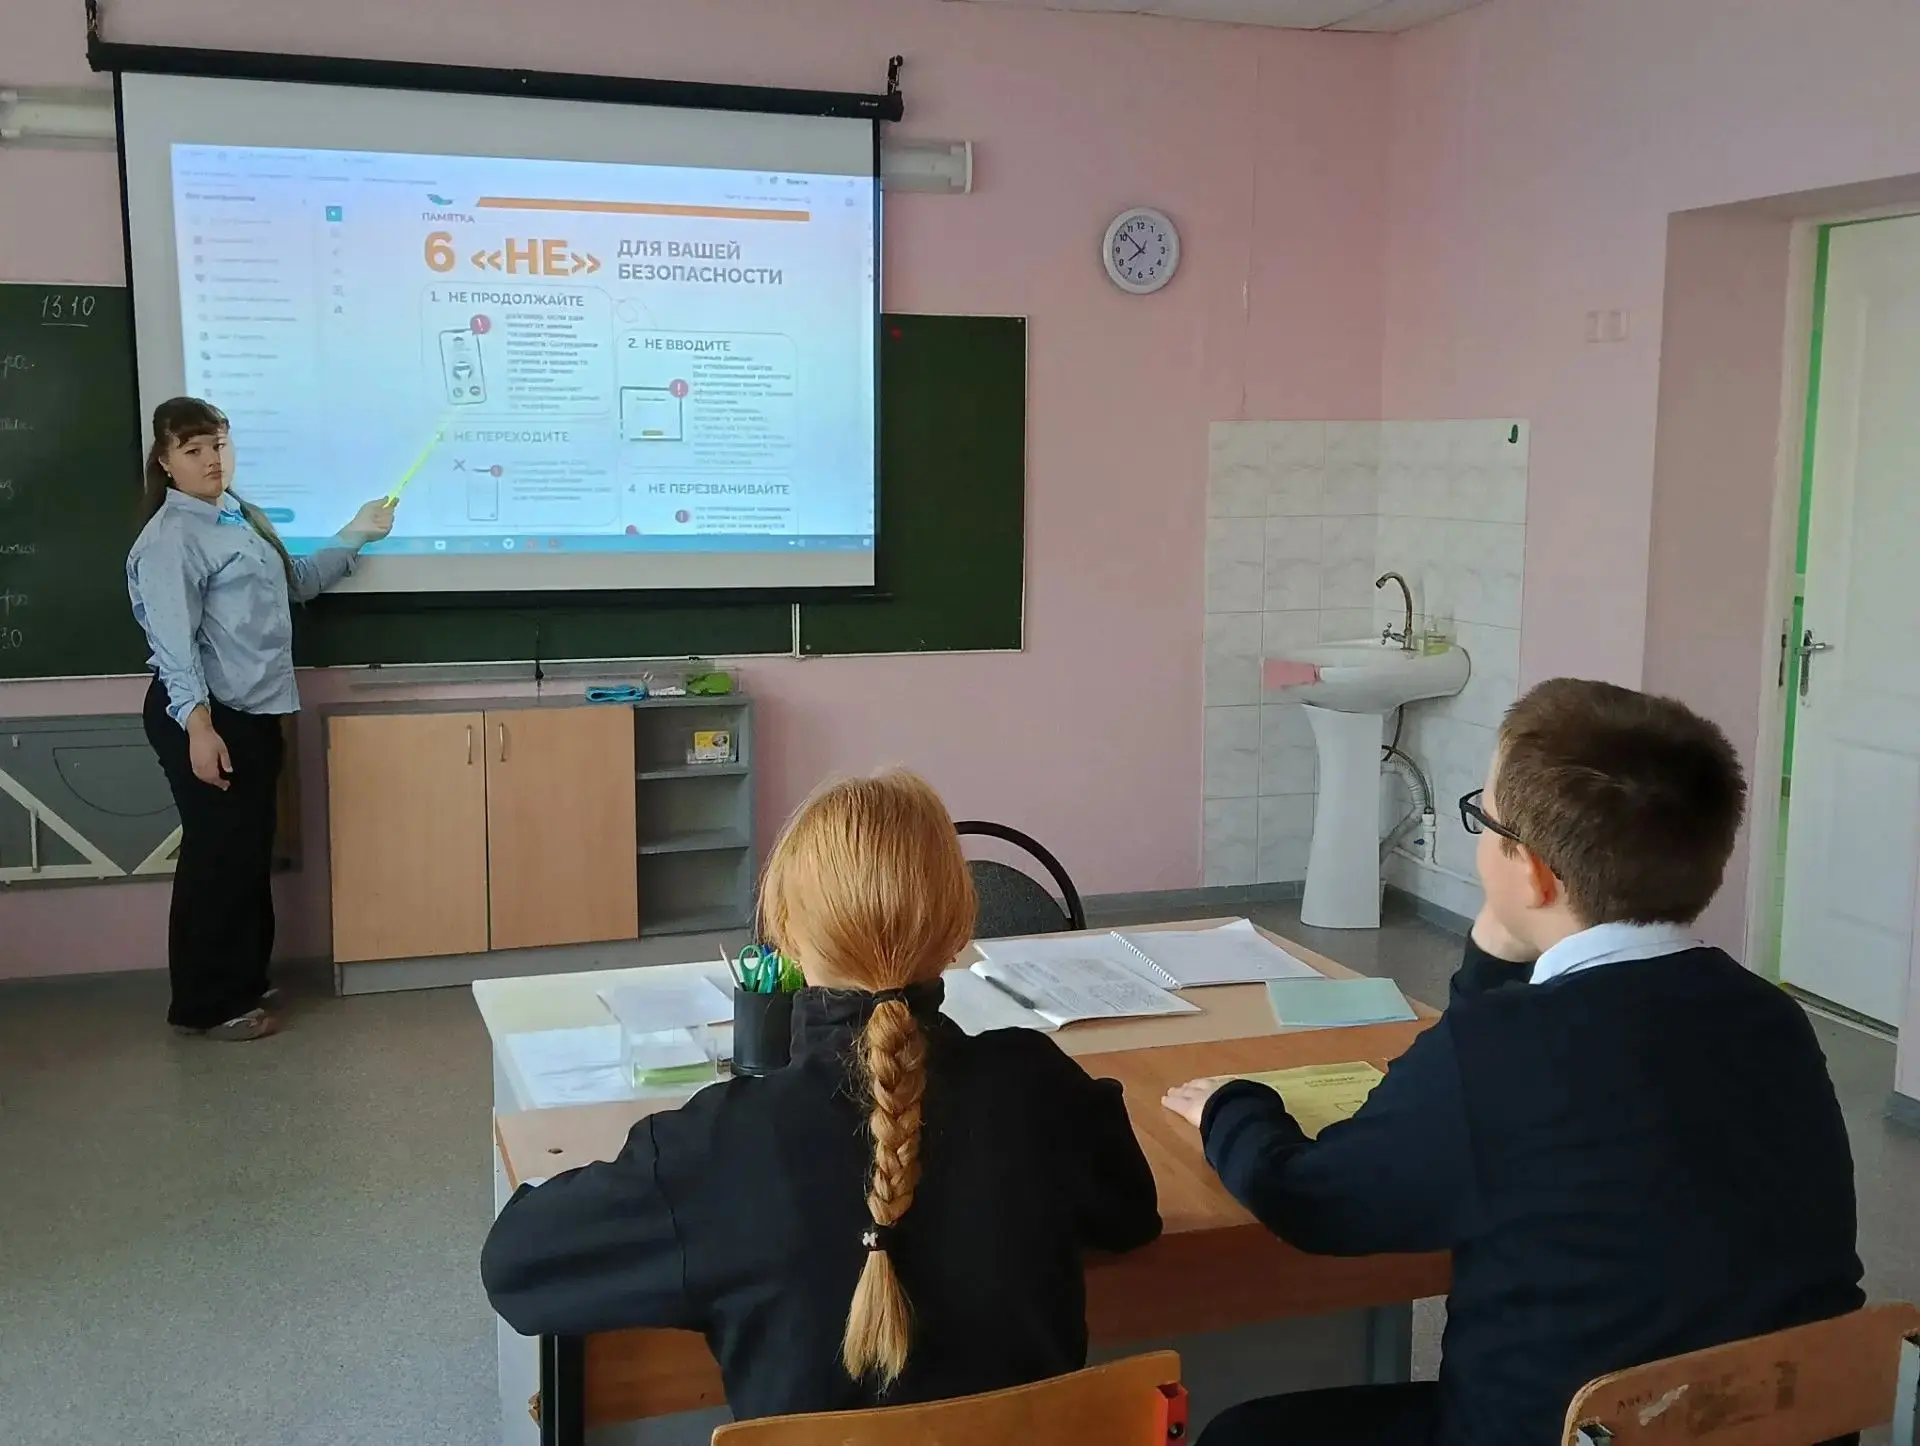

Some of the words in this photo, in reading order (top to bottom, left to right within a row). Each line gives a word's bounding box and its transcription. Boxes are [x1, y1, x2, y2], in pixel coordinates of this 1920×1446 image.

[421, 212, 475, 224] ПАМЯТКА
[424, 231, 456, 273] 6
[617, 239, 662, 258] ДЛЯ
[667, 241, 741, 260] ВАШЕЙ
[617, 263, 783, 285] БЕЗОПАСНОСТИ
[448, 292, 467, 303] НЕ
[471, 292, 585, 307] ПРОДОЛЖАЙТЕ
[645, 339, 662, 350] НЕ
[666, 340, 732, 351] ВВОДИТЕ
[454, 432, 472, 442] НЕ
[477, 432, 570, 443] ПЕРЕХОДИТЕ
[649, 484, 666, 493] НЕ
[670, 483, 790, 495] ПЕРЕЗВАНИВАЙТЕ
